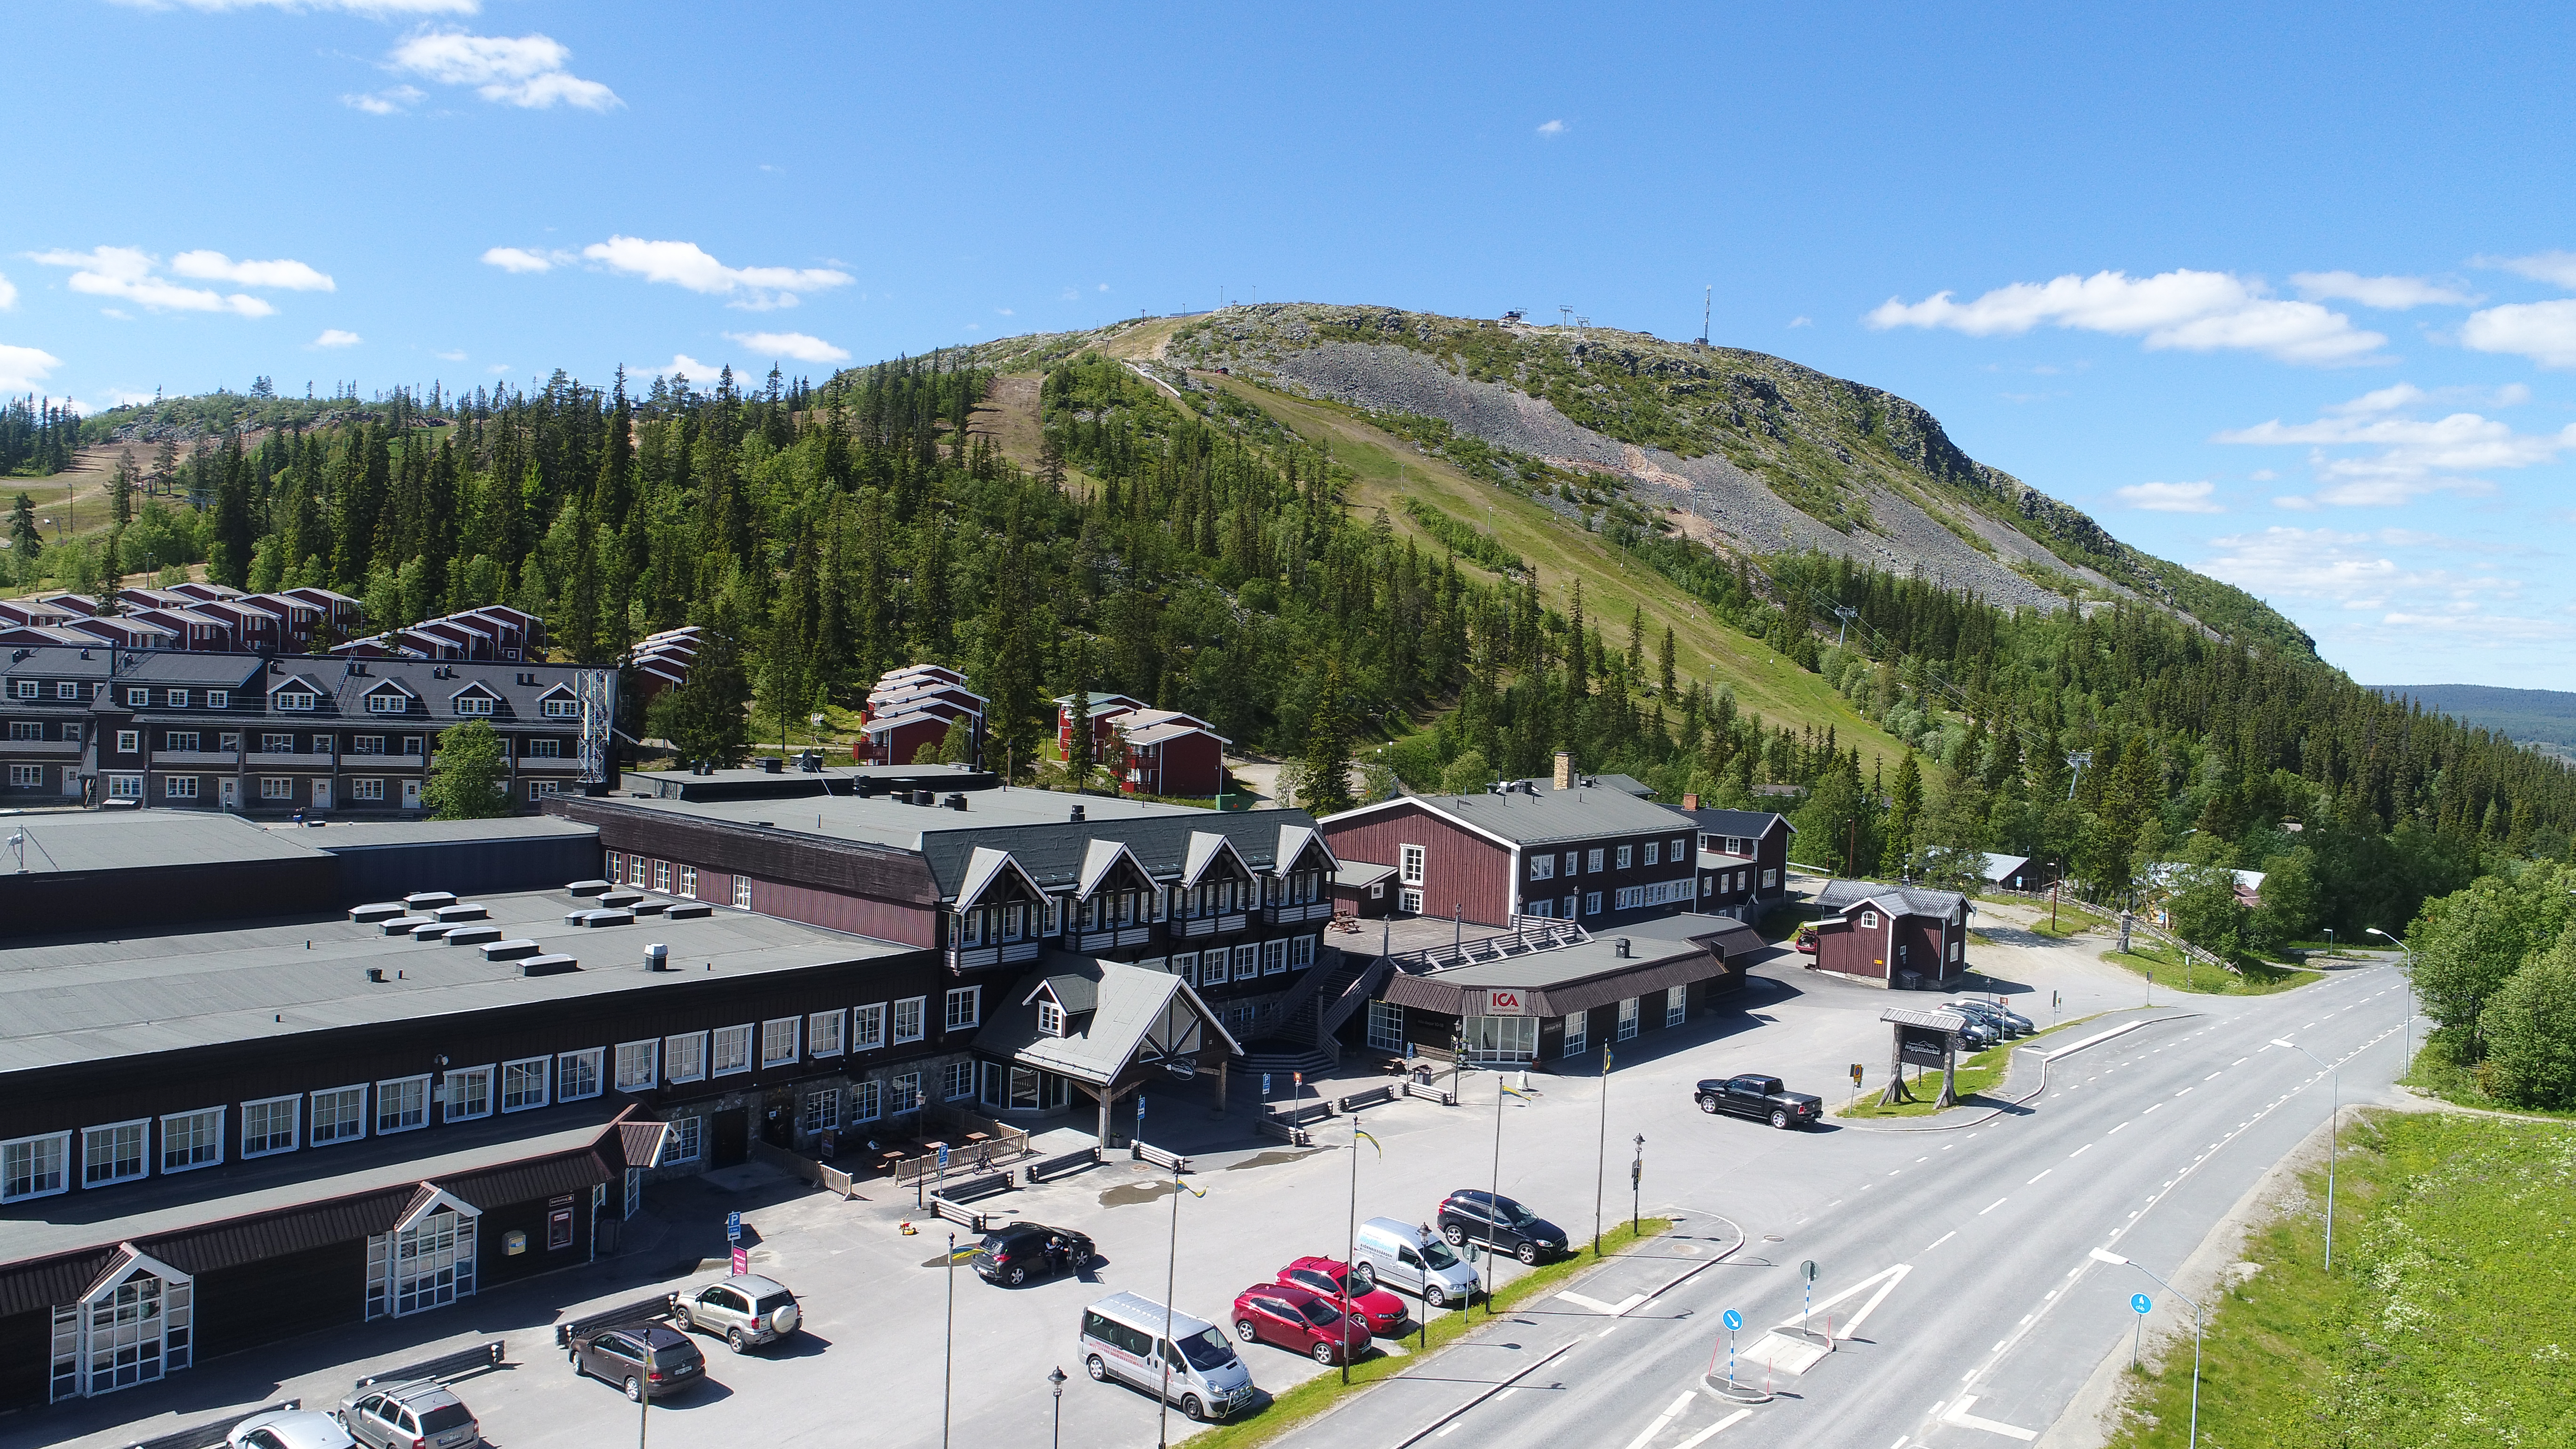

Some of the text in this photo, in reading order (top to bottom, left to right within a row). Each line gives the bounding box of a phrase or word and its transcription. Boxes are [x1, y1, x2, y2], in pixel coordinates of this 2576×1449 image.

[1492, 992, 1519, 1007] ICA
[1264, 1076, 1269, 1084] P
[1140, 1099, 1144, 1108] P
[941, 1146, 946, 1156] P
[731, 1214, 739, 1225] P
